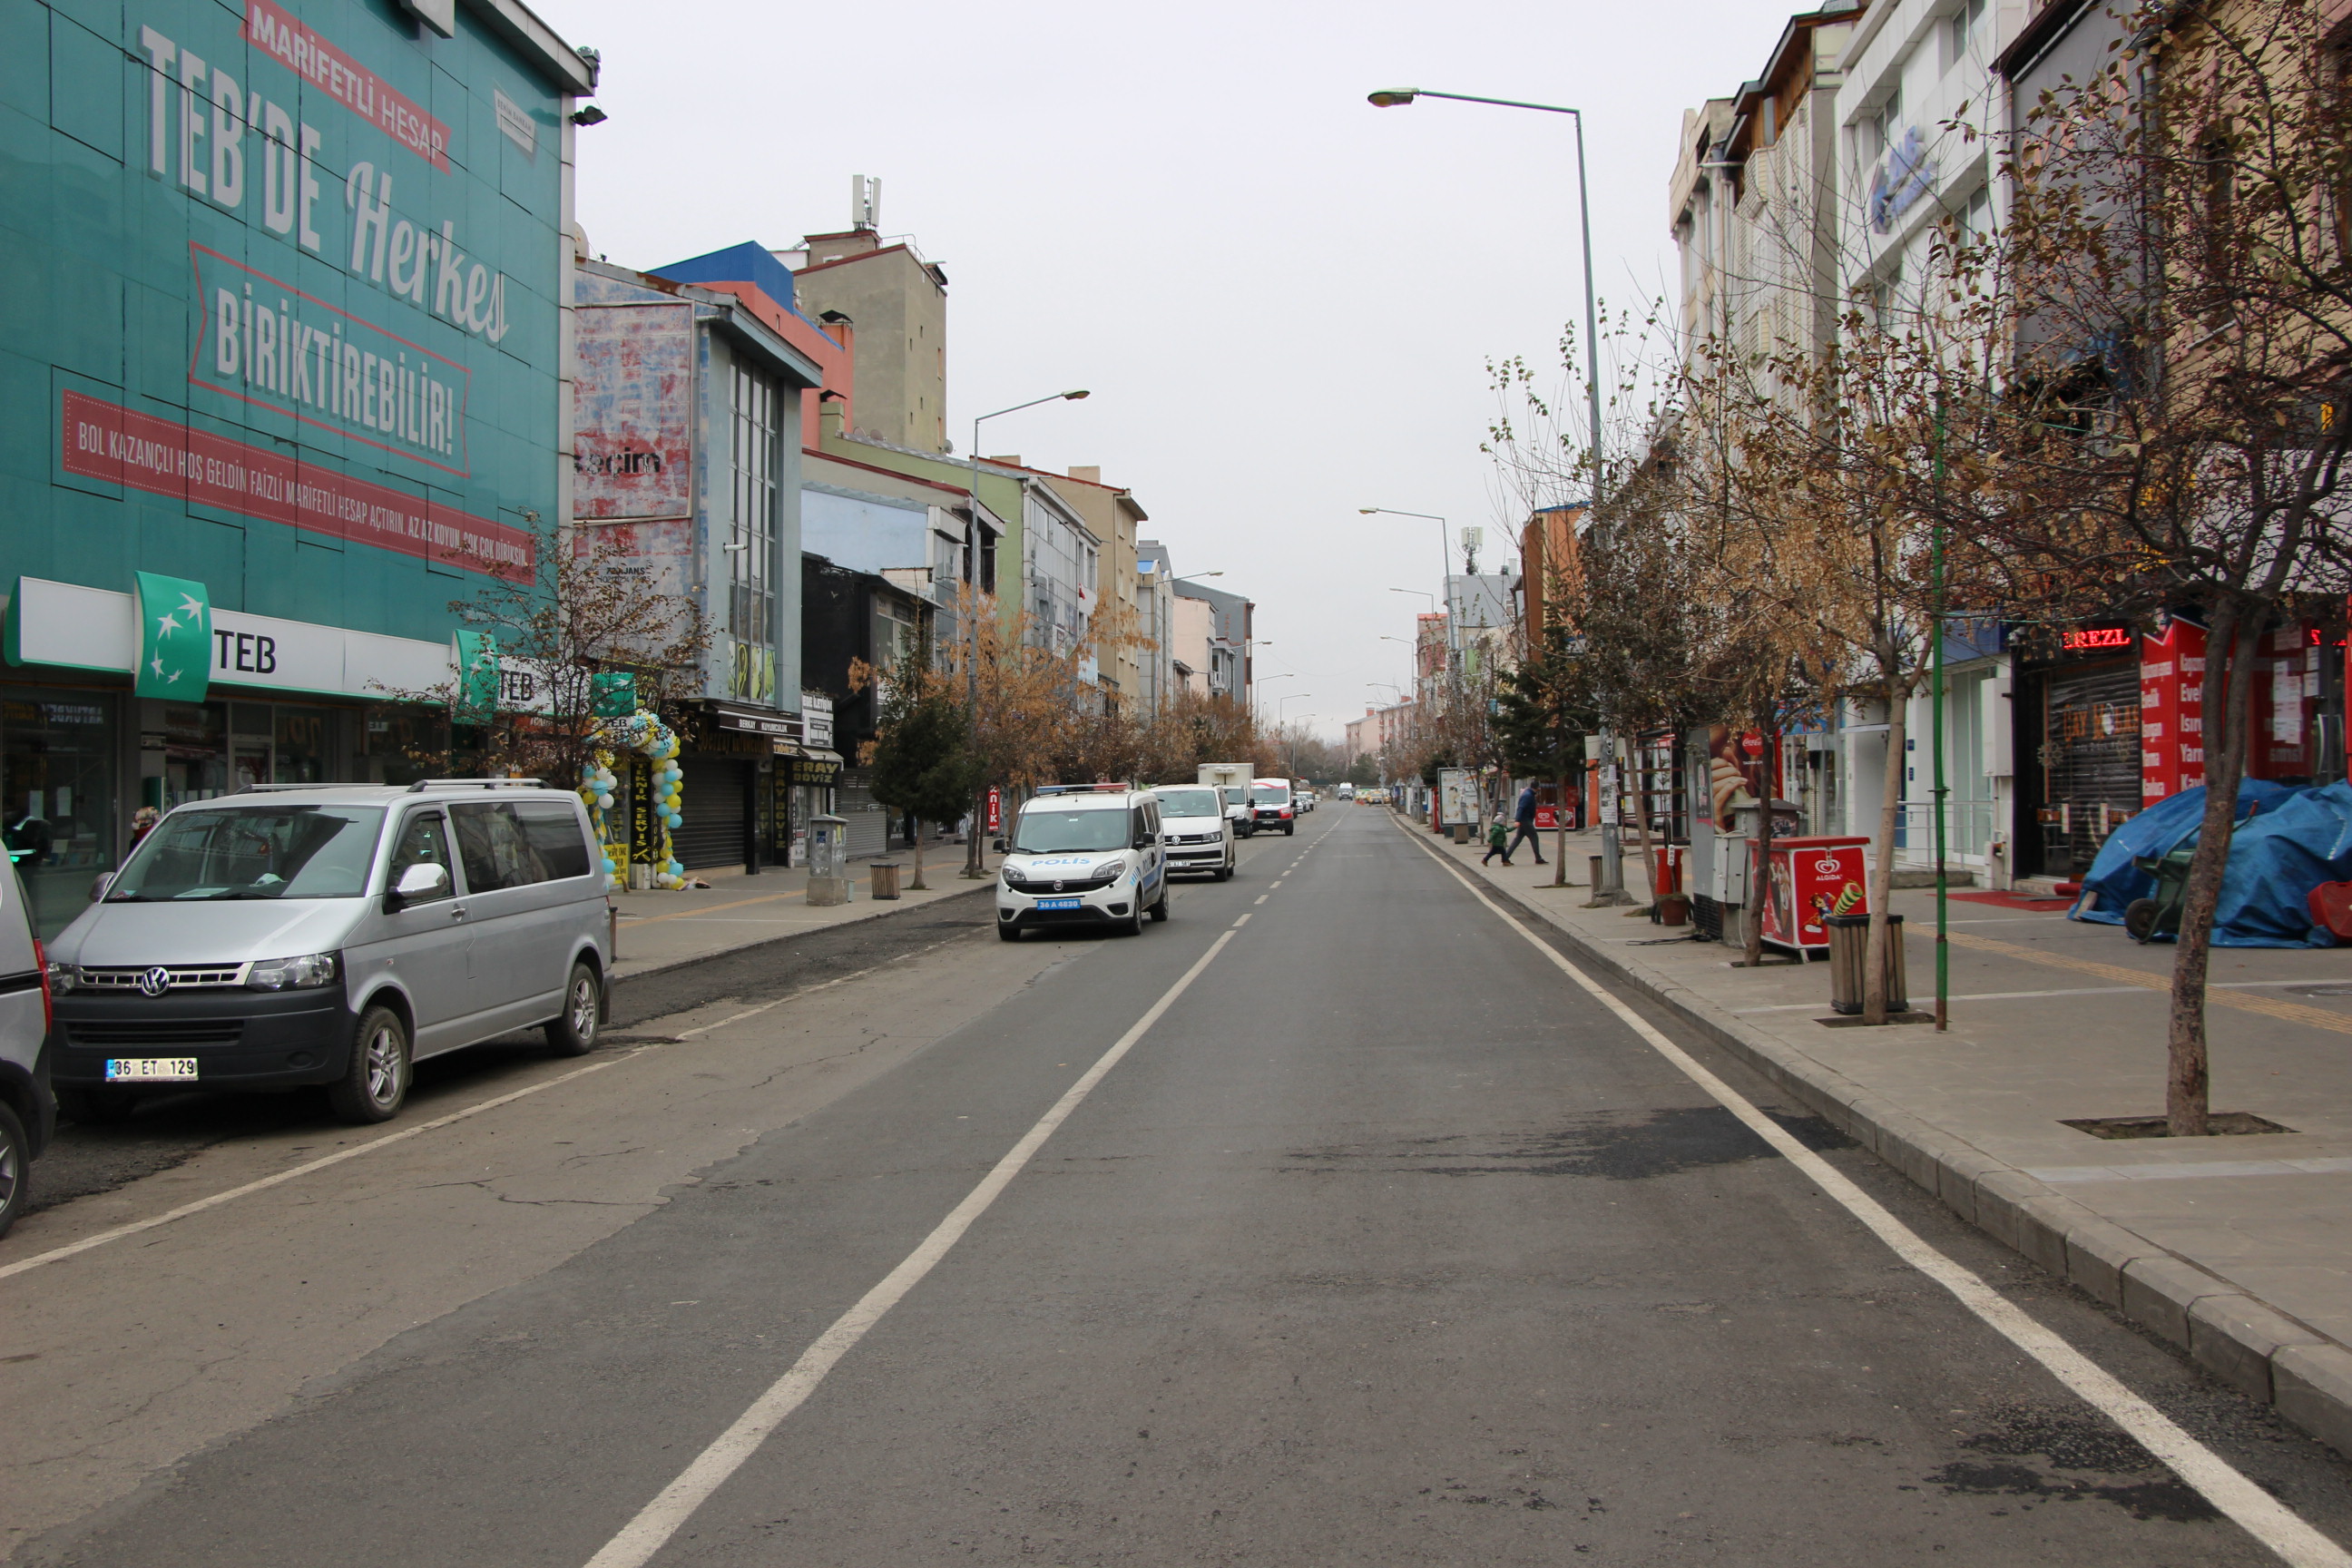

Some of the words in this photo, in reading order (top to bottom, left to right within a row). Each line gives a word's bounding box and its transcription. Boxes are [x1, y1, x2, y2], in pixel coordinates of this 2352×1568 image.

[251, 4, 375, 117] MARİFETLİ
[381, 93, 443, 160] HESAP
[346, 161, 510, 342] Herkes
[217, 282, 453, 456] BİRİKTİREBİLİR!
[78, 421, 104, 456] BOL
[109, 429, 173, 475] KAZANÇLI
[178, 449, 203, 485] HOŞ
[207, 457, 247, 493] GELDİN
[250, 467, 282, 503] FAİZLİ
[286, 479, 336, 516] MARİFETLİ
[338, 495, 368, 524] HESAP
[369, 504, 407, 535] AÇTIRIN.
[408, 515, 419, 538] AZ
[421, 518, 433, 543] AZ
[214, 629, 277, 674] TEB
[499, 669, 534, 701] TEB
[739, 719, 756, 730] BERKAY
[761, 721, 788, 733] KUYUMCULUK
[792, 761, 838, 774] ERAY
[635, 807, 648, 847] SERVİS
[1031, 857, 1091, 867] POLİS
[114, 1060, 132, 1075] 36
[142, 1060, 158, 1075] ET
[171, 1060, 194, 1075] 129
